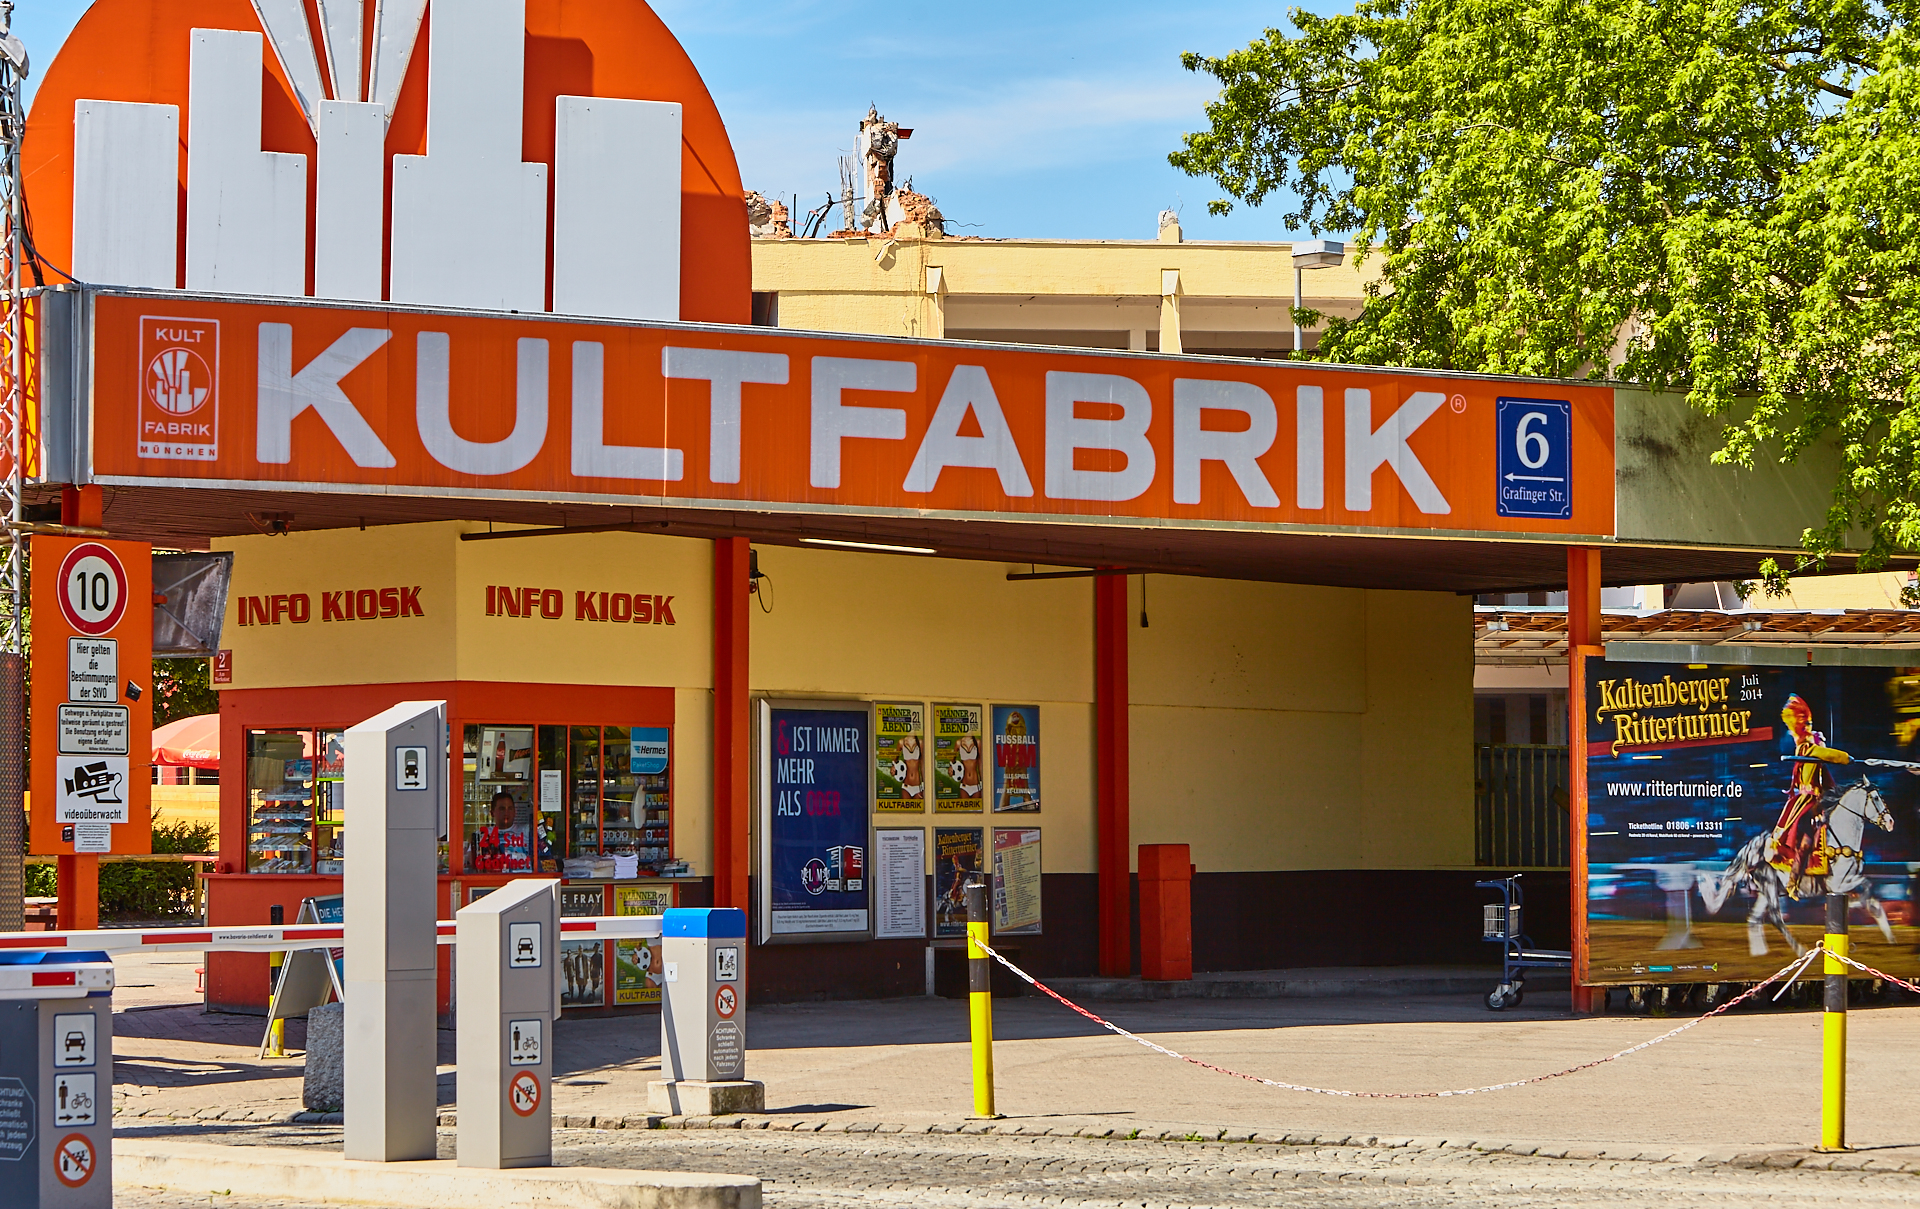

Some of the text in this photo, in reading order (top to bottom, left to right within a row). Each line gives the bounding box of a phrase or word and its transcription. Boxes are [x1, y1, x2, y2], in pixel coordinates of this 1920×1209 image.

[156, 328, 205, 343] KULT
[257, 321, 1451, 515] KULTFABRIK
[144, 421, 211, 437] FABRIK
[1515, 411, 1550, 469] 6
[139, 445, 217, 457] MÜNCHEN
[1503, 486, 1566, 504] Grafinger Str.
[76, 571, 109, 612] 10
[237, 585, 425, 626] INFO KIOSK
[485, 585, 677, 626] INFO KIOSK
[76, 642, 111, 658] Hier gelten
[88, 658, 99, 670] die
[219, 652, 226, 668] 2
[71, 670, 117, 686] Bestimmungen
[1741, 674, 1760, 688] Juli
[79, 687, 107, 699] der StVO
[1596, 674, 1731, 723] Kaltenberger
[1740, 688, 1763, 702] 2014
[65, 708, 85, 718] Gehwege
[90, 709, 113, 718] Parkplätze
[882, 706, 911, 717] MÄNNER
[912, 711, 921, 723] 21
[940, 707, 969, 718] MÄNNER
[82, 719, 100, 727] geräumt
[969, 712, 979, 724] 21
[74, 727, 96, 737] Benutzung
[98, 728, 112, 737] erfolgt
[882, 722, 912, 733] ABEND
[940, 723, 969, 733] ABEND
[1611, 704, 1752, 758] Ritterturnier
[78, 737, 92, 746] eigene
[793, 726, 812, 753] IST
[816, 726, 860, 753] IMMER
[995, 734, 1036, 744] FUSSBALL
[640, 745, 666, 755] Hermes
[632, 761, 660, 769] PaketShop
[777, 757, 815, 784] MEHR
[1607, 779, 1743, 798] www.ritterturnier.de
[777, 790, 841, 817] ALS ODER
[878, 801, 922, 809] KULTFABRIK
[938, 800, 981, 809] KULTFABRIK
[64, 808, 122, 820] videoüberwacht
[1628, 822, 1663, 830] Tickethotline
[1666, 820, 1690, 830] 01806
[478, 825, 528, 848] 24 Std.
[475, 853, 531, 870] Geöffnet
[573, 893, 602, 904] FRAY
[623, 889, 657, 900] MÄNNER
[658, 893, 668, 906] 21
[319, 908, 331, 919] DIE
[623, 906, 657, 916] ABEND
[620, 990, 662, 1000] KULTFABR
[713, 1047, 739, 1055] automatisch
